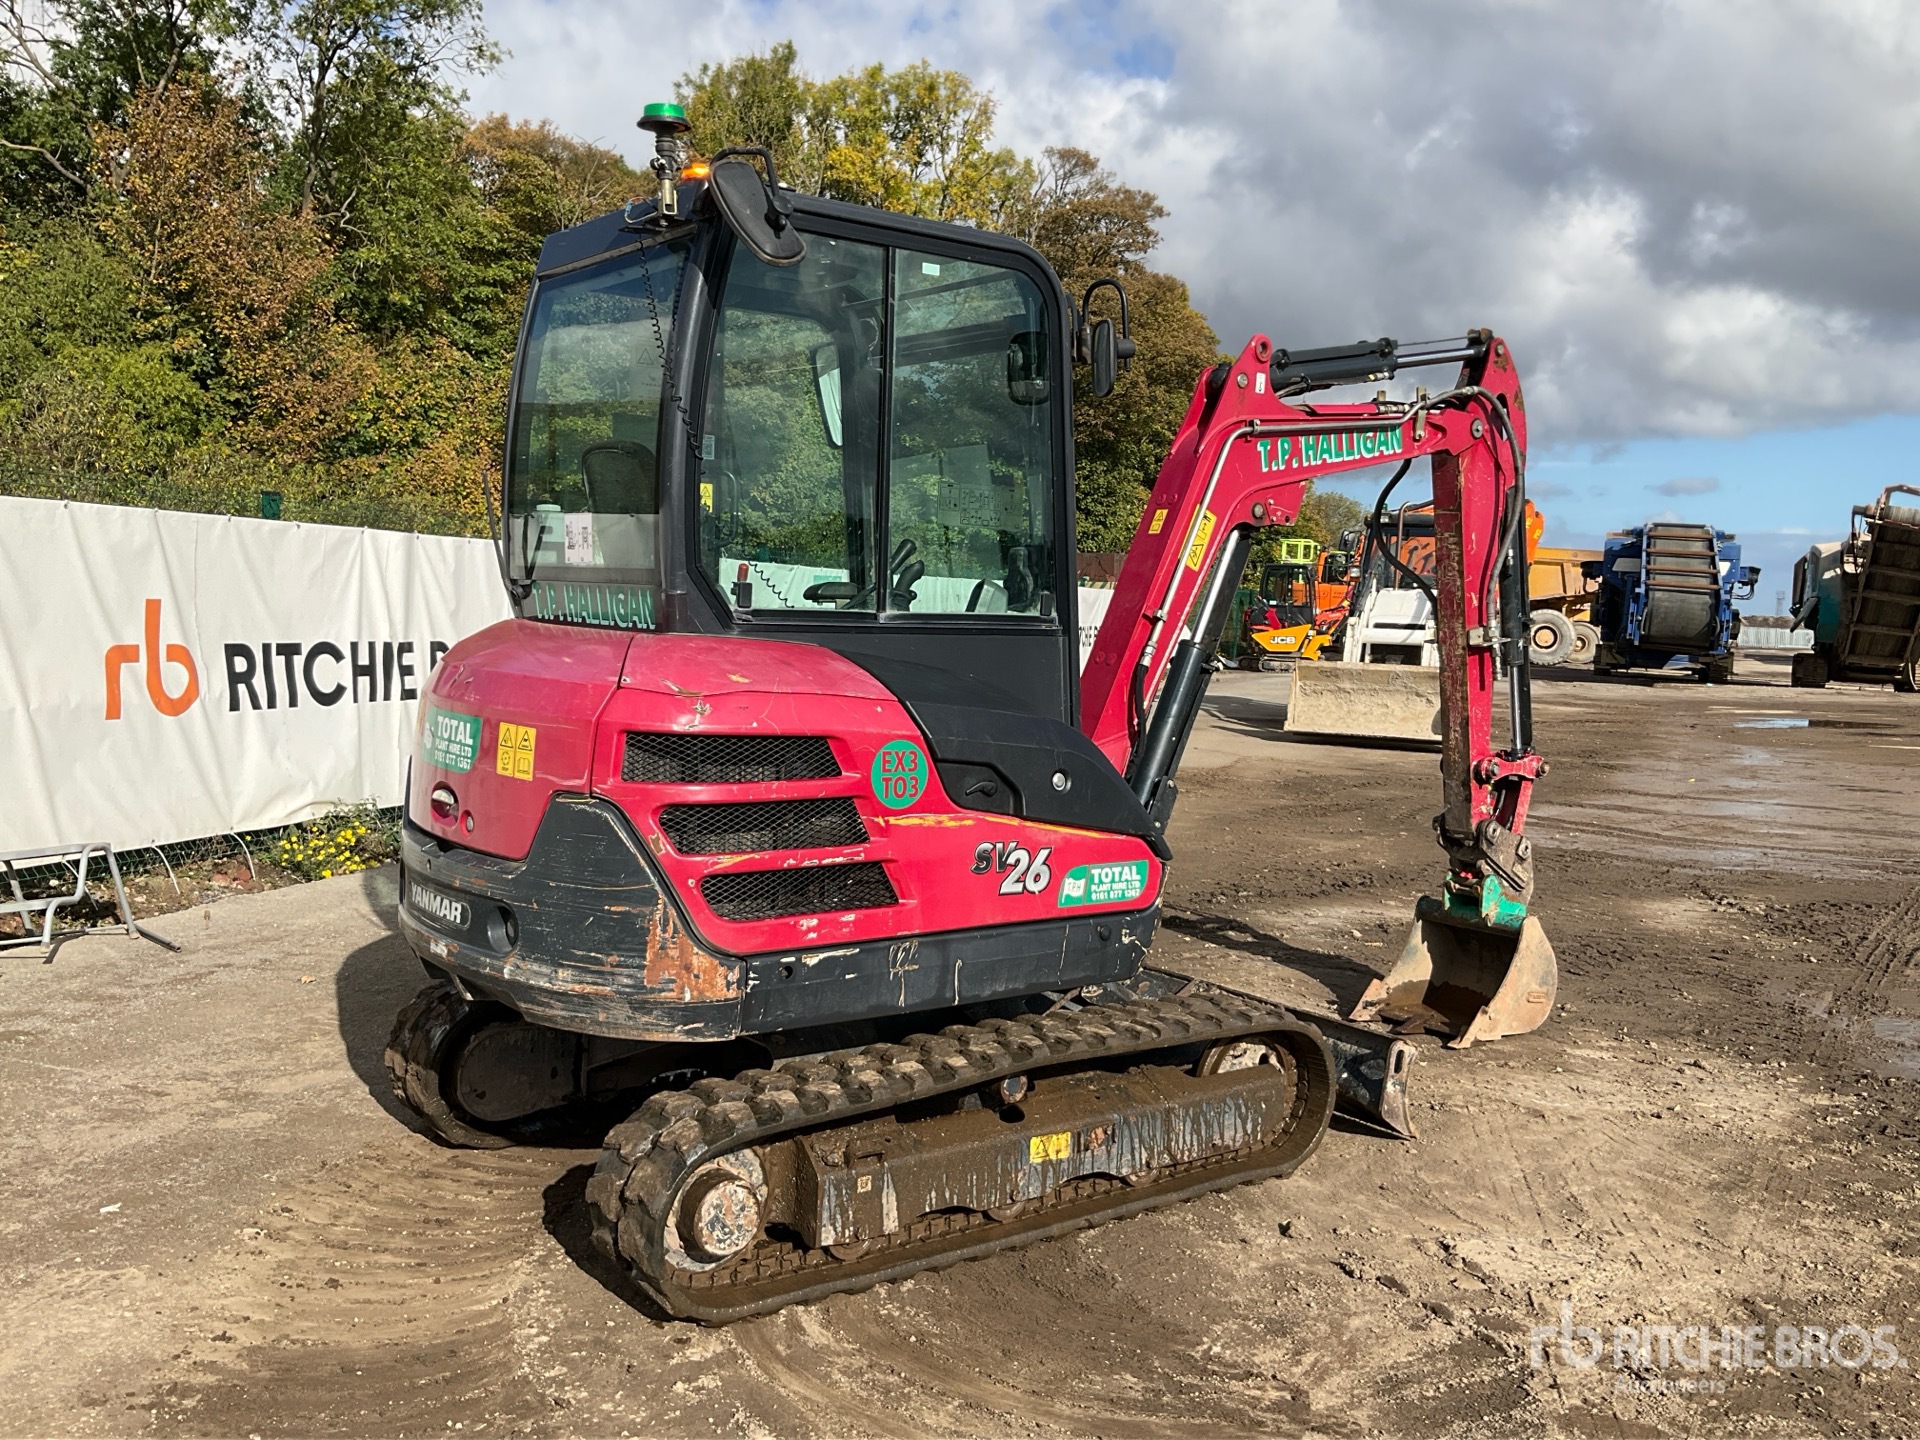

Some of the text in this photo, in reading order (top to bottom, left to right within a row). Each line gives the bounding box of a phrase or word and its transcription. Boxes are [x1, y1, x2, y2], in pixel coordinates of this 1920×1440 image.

[1257, 424, 1403, 472] T.P. HALLIGAN
[532, 582, 656, 630] T.P. HALLIGAN
[1269, 636, 1297, 644] JCB
[223, 640, 418, 712] RITCHIE
[437, 715, 473, 746] TOTAL
[435, 738, 472, 758] PLANT HIRE LTD
[457, 756, 471, 770] 1367
[880, 750, 919, 774] EX3
[1091, 866, 1141, 884] TOTAL
[1091, 880, 1141, 892] PLANT HIRE LTD
[411, 881, 462, 924] YANMAR
[1091, 891, 1108, 901] 0161
